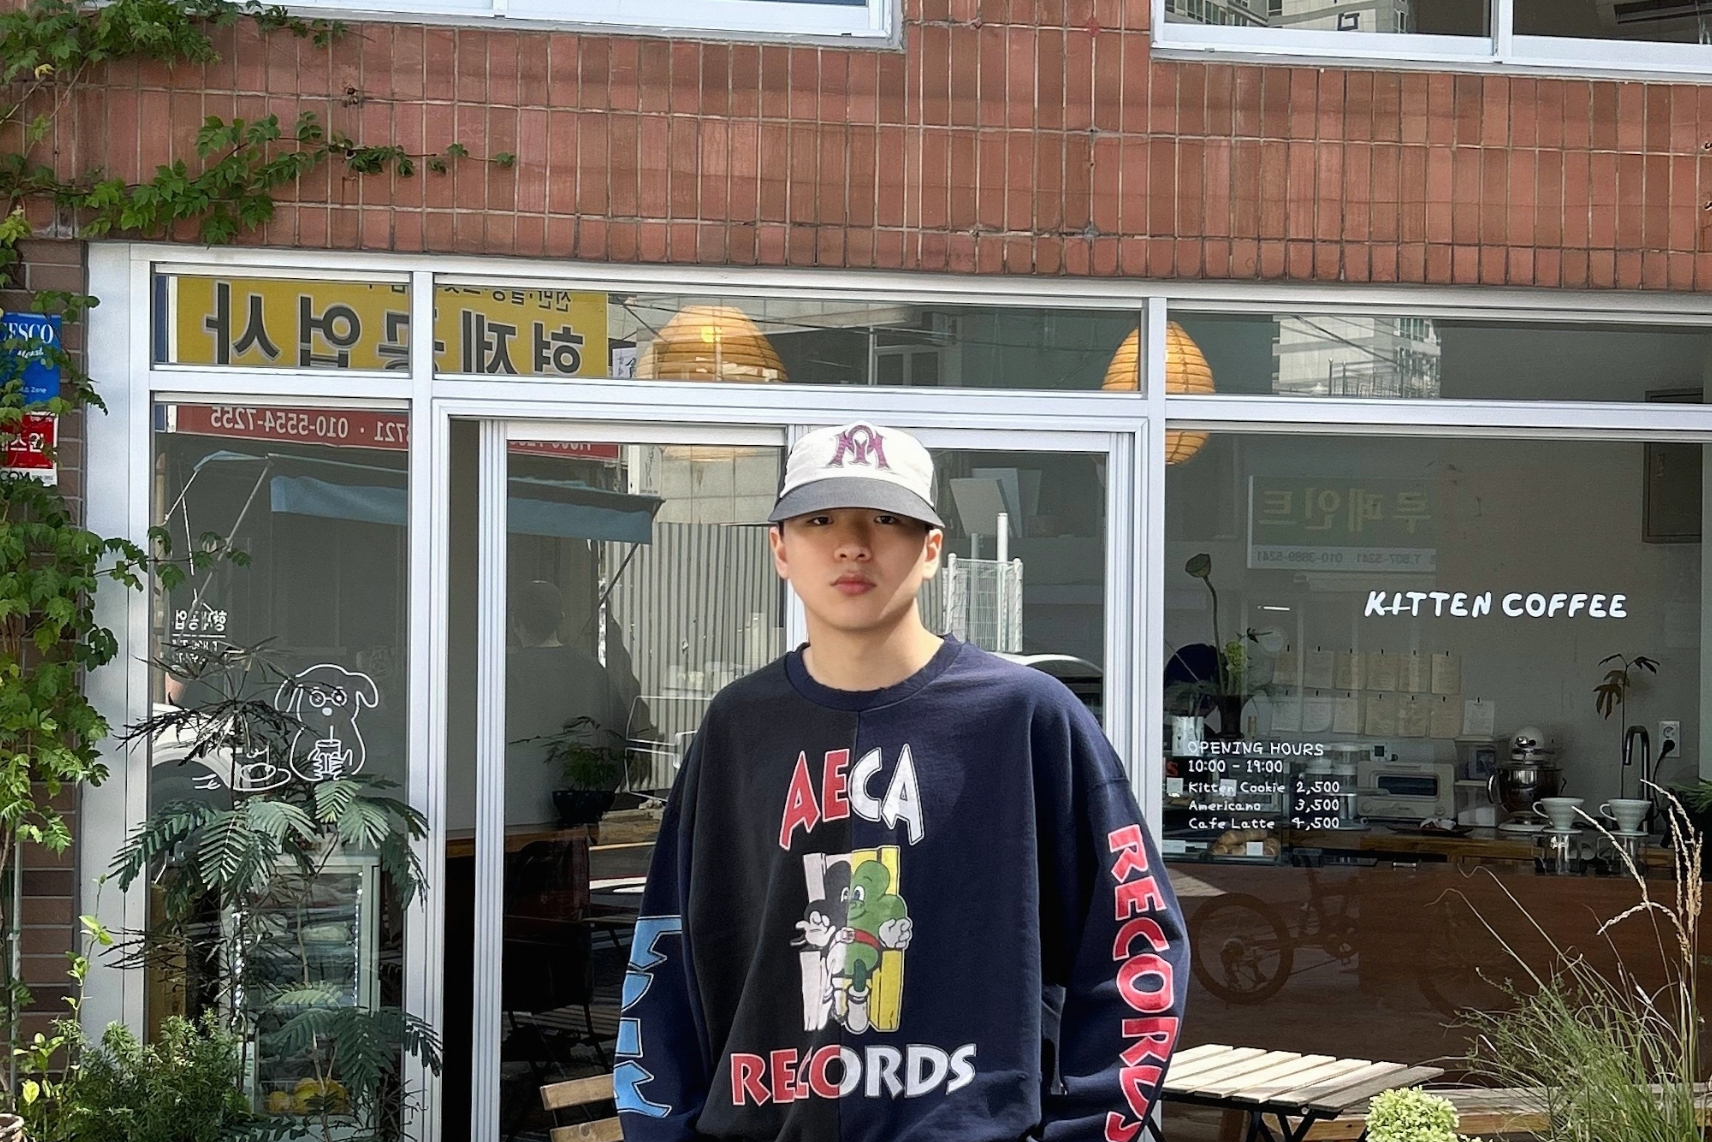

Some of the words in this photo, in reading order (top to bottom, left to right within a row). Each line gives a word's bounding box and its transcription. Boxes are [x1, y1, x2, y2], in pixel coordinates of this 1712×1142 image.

[1364, 590, 1492, 618] KITTEN
[1501, 592, 1628, 618] COFFEE
[1187, 741, 1264, 756] OPENING
[1270, 742, 1325, 756] HOURS
[1188, 759, 1226, 773] 10:00
[1246, 759, 1283, 773] 19:00
[1188, 781, 1236, 794] Kitten
[1240, 782, 1286, 794] Cookie
[1295, 781, 1340, 796] 2,500
[779, 743, 925, 850] AECA
[1188, 799, 1262, 812] Americano
[1294, 799, 1340, 813] 3,500
[1188, 817, 1227, 830] Cafe
[1231, 817, 1276, 830] Latte
[1291, 816, 1340, 831] 4,500
[730, 1044, 977, 1107] RECORDS
